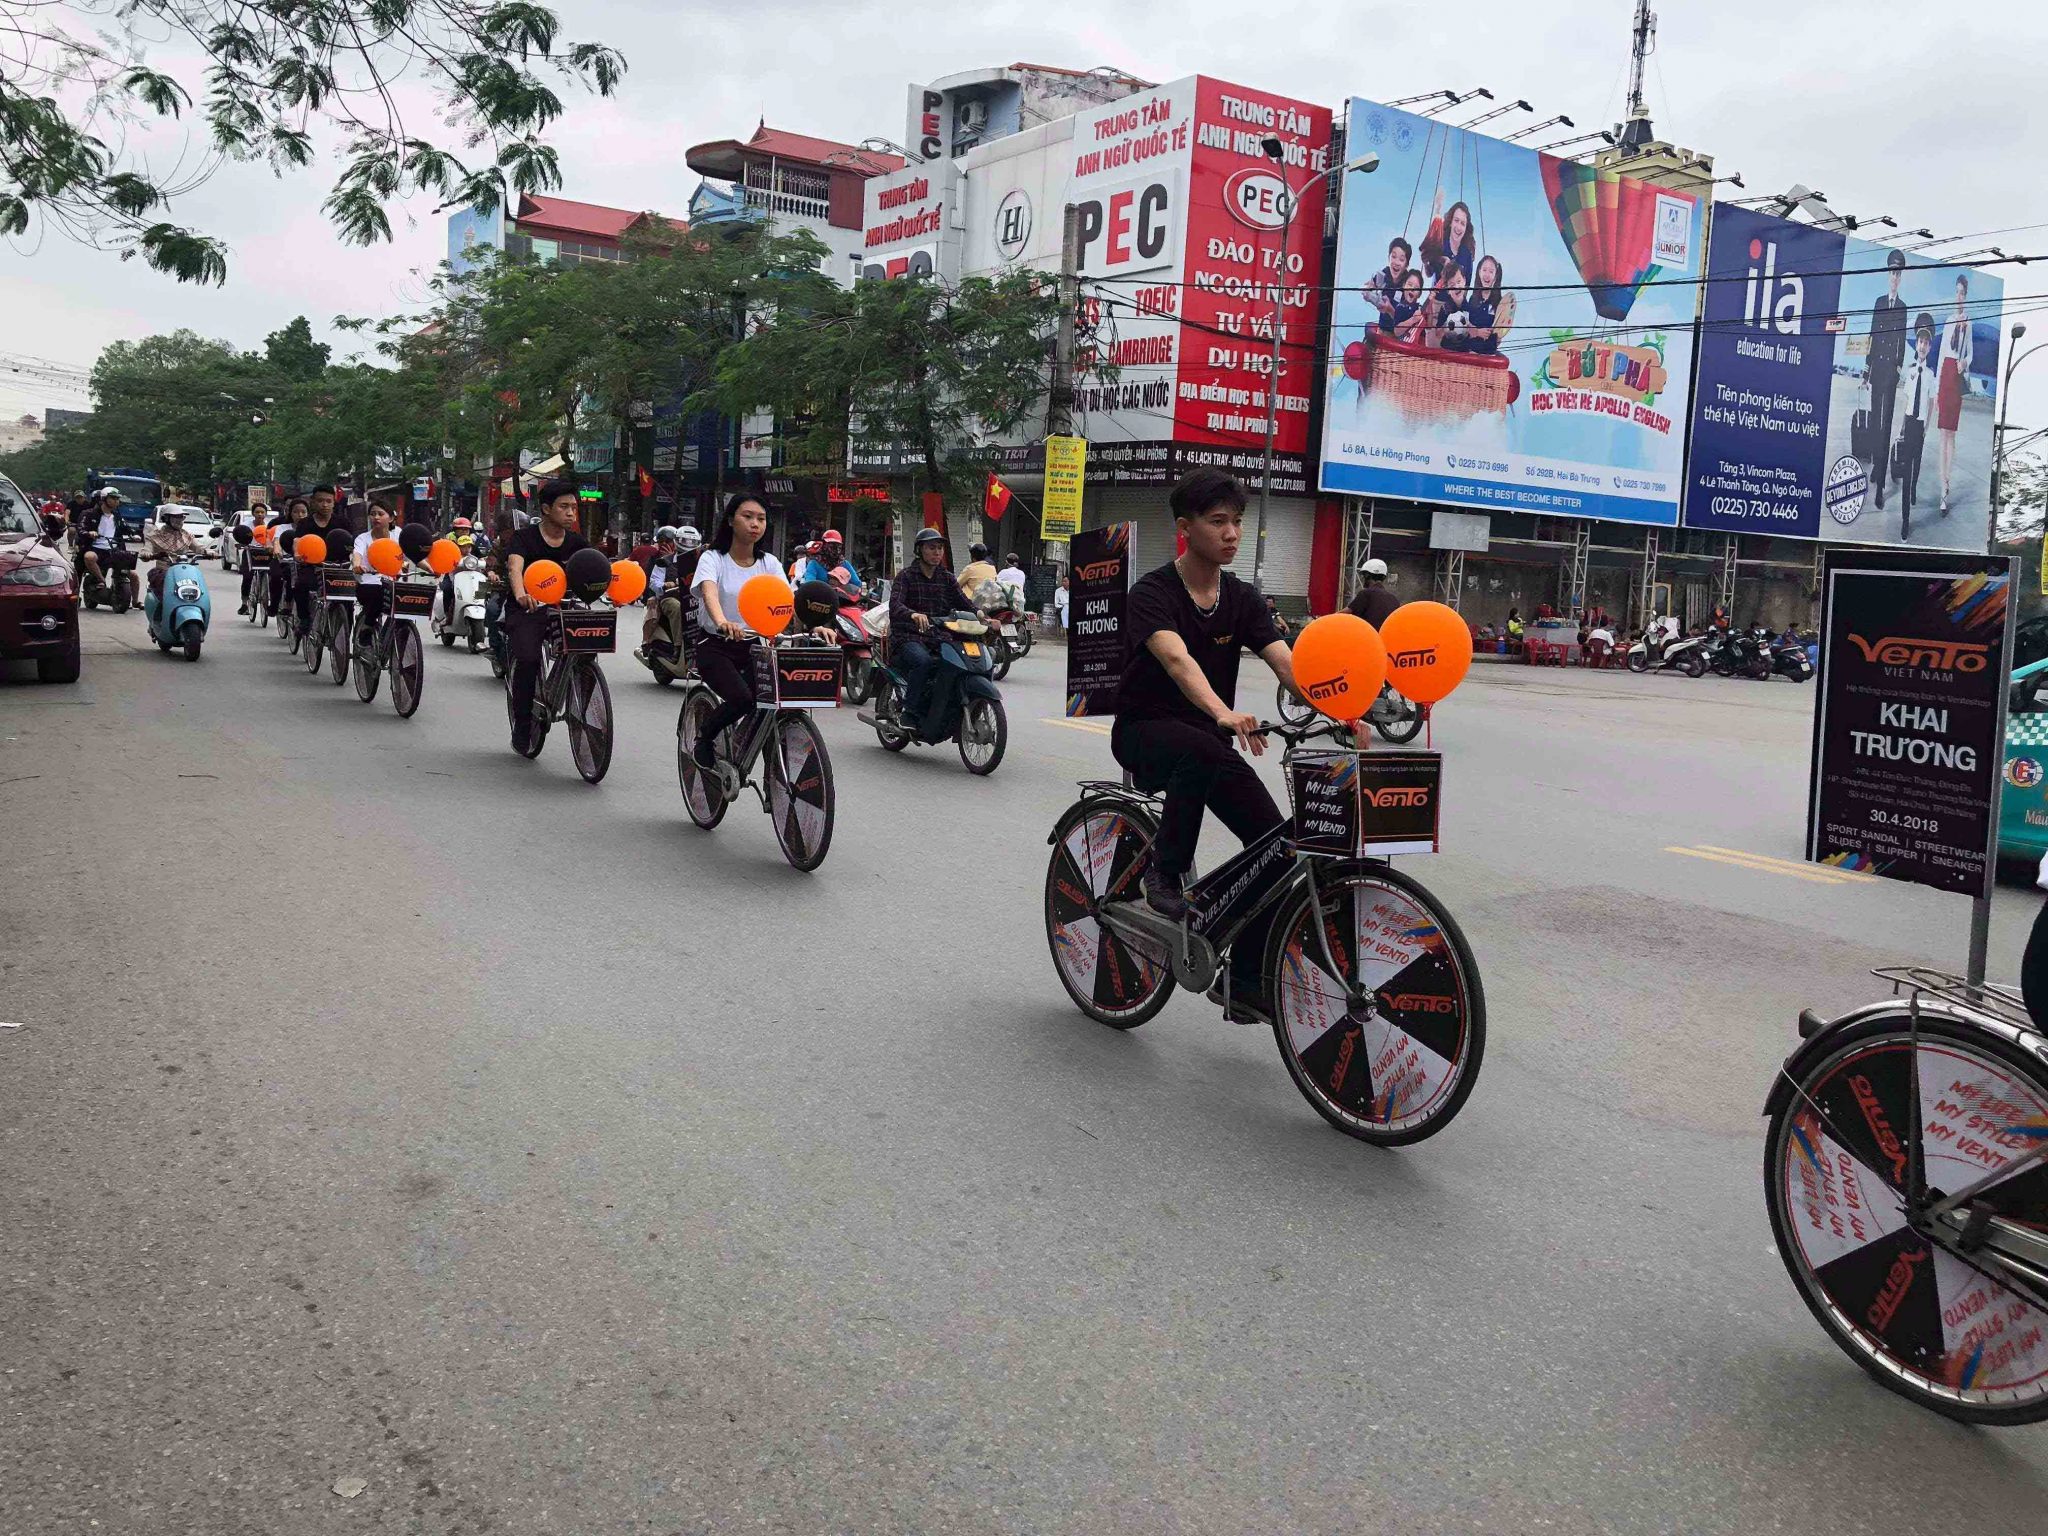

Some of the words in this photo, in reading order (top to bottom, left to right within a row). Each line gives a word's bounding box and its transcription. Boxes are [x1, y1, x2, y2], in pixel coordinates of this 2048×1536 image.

[920, 90, 943, 160] PEC
[1094, 109, 1138, 140] TRUNG
[1141, 97, 1171, 126] TÂM
[1221, 95, 1275, 128] TRUNG
[1277, 106, 1311, 137] TÂM
[1075, 151, 1100, 177] ANH
[1103, 137, 1132, 170] NGỮ
[1133, 125, 1168, 163] QUỐC
[1171, 117, 1189, 151] TẾ
[1197, 122, 1231, 150] ANH
[1267, 136, 1307, 168] UỐC
[1310, 144, 1329, 172] TẾ
[878, 183, 907, 211] TRUNG
[908, 177, 929, 201] TÂM
[1244, 184, 1288, 216] PEC
[865, 226, 883, 248] ANH
[884, 214, 903, 242] NGỮ
[903, 207, 928, 238] QUỐC
[1078, 183, 1168, 271] PEC
[1208, 237, 1255, 264] ĐÀO
[1261, 248, 1304, 275] TẠO
[1655, 240, 1686, 256] JUNIOR
[1136, 285, 1177, 317] TOEIC
[1194, 271, 1261, 302] NGOẠI
[1744, 239, 1804, 335] ila
[1216, 312, 1245, 334] TƯ
[1108, 335, 1173, 367] CAMBRIDGE
[1208, 347, 1238, 370] DU
[1243, 352, 1288, 379] HỌC
[1736, 337, 1774, 361] education
[1775, 343, 1787, 364] for
[1788, 345, 1802, 366] life
[1089, 388, 1101, 412] DU
[1103, 385, 1120, 415] HỌC
[1123, 379, 1140, 409] CÁC
[1143, 376, 1170, 408] NƯỚC
[1179, 382, 1198, 402] ĐỊA
[1200, 378, 1227, 403] ĐIỂM
[1228, 389, 1250, 408] HỌC
[1252, 388, 1266, 407] VÀ
[1284, 396, 1310, 413] IELTS
[1531, 393, 1553, 415] HỌC
[1556, 386, 1578, 413] VIỆN
[1580, 387, 1593, 412] HÈ
[1594, 395, 1631, 419] APOLLO
[1634, 406, 1673, 436] ENGLISH
[1716, 383, 1737, 402] Tiên
[1739, 389, 1771, 412] phong
[1773, 393, 1793, 411] kiến
[1795, 399, 1813, 416] tạo
[1207, 412, 1223, 431] TẠI
[1225, 411, 1243, 431] HẢI
[1704, 405, 1721, 422] thế
[1722, 407, 1736, 427] hệ
[1738, 409, 1758, 429] Việt
[1760, 414, 1785, 432] Nam
[1787, 421, 1801, 434] ưu
[1802, 420, 1820, 438] việt
[1175, 450, 1182, 462] 41
[1187, 451, 1195, 463] 45
[1195, 451, 1211, 467] LẠCH
[1213, 453, 1229, 466] TRAY
[1232, 452, 1245, 468] NGÔ
[1270, 455, 1280, 471] HẢI
[1281, 456, 1302, 473] PHÒNG
[1342, 443, 1353, 454] Lô
[1355, 445, 1368, 457] 8A,
[1370, 446, 1380, 457] Lê
[1382, 447, 1404, 462] Hồng
[1405, 451, 1431, 465] Phong
[1458, 458, 1476, 469] 0225
[1477, 460, 1491, 471] 373
[1719, 460, 1738, 477] Tầng
[1739, 464, 1746, 474] 3,
[1747, 464, 1774, 479] Vincom
[1775, 469, 1797, 483] Plaza,
[765, 480, 794, 493] JINXIU
[1526, 466, 1536, 477] Số
[1557, 470, 1569, 480] Hai
[1569, 471, 1579, 482] Bà
[1580, 473, 1600, 487] Trưng
[1623, 479, 1638, 489] 0225
[1700, 476, 1705, 486] 4
[1706, 475, 1717, 488] Lê
[1717, 477, 1740, 491] Thánh
[1742, 479, 1761, 495] Tông,
[1762, 482, 1771, 494] Q.
[1772, 484, 1788, 497] Ngô
[1444, 483, 1475, 497] WHERE
[1477, 486, 1493, 498] THE
[1494, 489, 1515, 501] BEST
[1516, 491, 1551, 505] BECOME
[1552, 496, 1582, 508] BETTER
[1711, 496, 1748, 518] (0225)
[1750, 501, 1771, 518] 730
[1772, 503, 1798, 520] 4466
[1086, 599, 1109, 616] KHAI
[1077, 616, 1118, 636] TRƯƠNG
[1884, 666, 1914, 678] VIET
[1921, 670, 1954, 683] NAM
[1880, 702, 1948, 734] KHAI
[1850, 731, 1976, 772] TRƯƠNG
[1306, 781, 1320, 793] MY
[1321, 783, 1339, 796] LIFE
[1305, 801, 1318, 813] MY
[1319, 802, 1343, 816] STYLE
[1869, 809, 1938, 833] 30.4.2018
[1305, 819, 1318, 830] MY
[1319, 820, 1346, 835] VENTO
[1826, 823, 1858, 838] SPORT
[1861, 829, 1900, 845] SANDAL
[1914, 840, 1986, 861] STREETWEAR
[1260, 840, 1281, 867] VENTO
[1828, 834, 1862, 849] SLIDES
[1875, 844, 1918, 860] SLIPPER
[1932, 855, 1983, 873] SNEAKER
[1375, 938, 1411, 966] VENTO
[1934, 1100, 1967, 1120] MY
[1966, 1115, 2025, 1149] STYLE
[1925, 1121, 1956, 1141] MY
[1956, 1136, 2009, 1168] VENT
